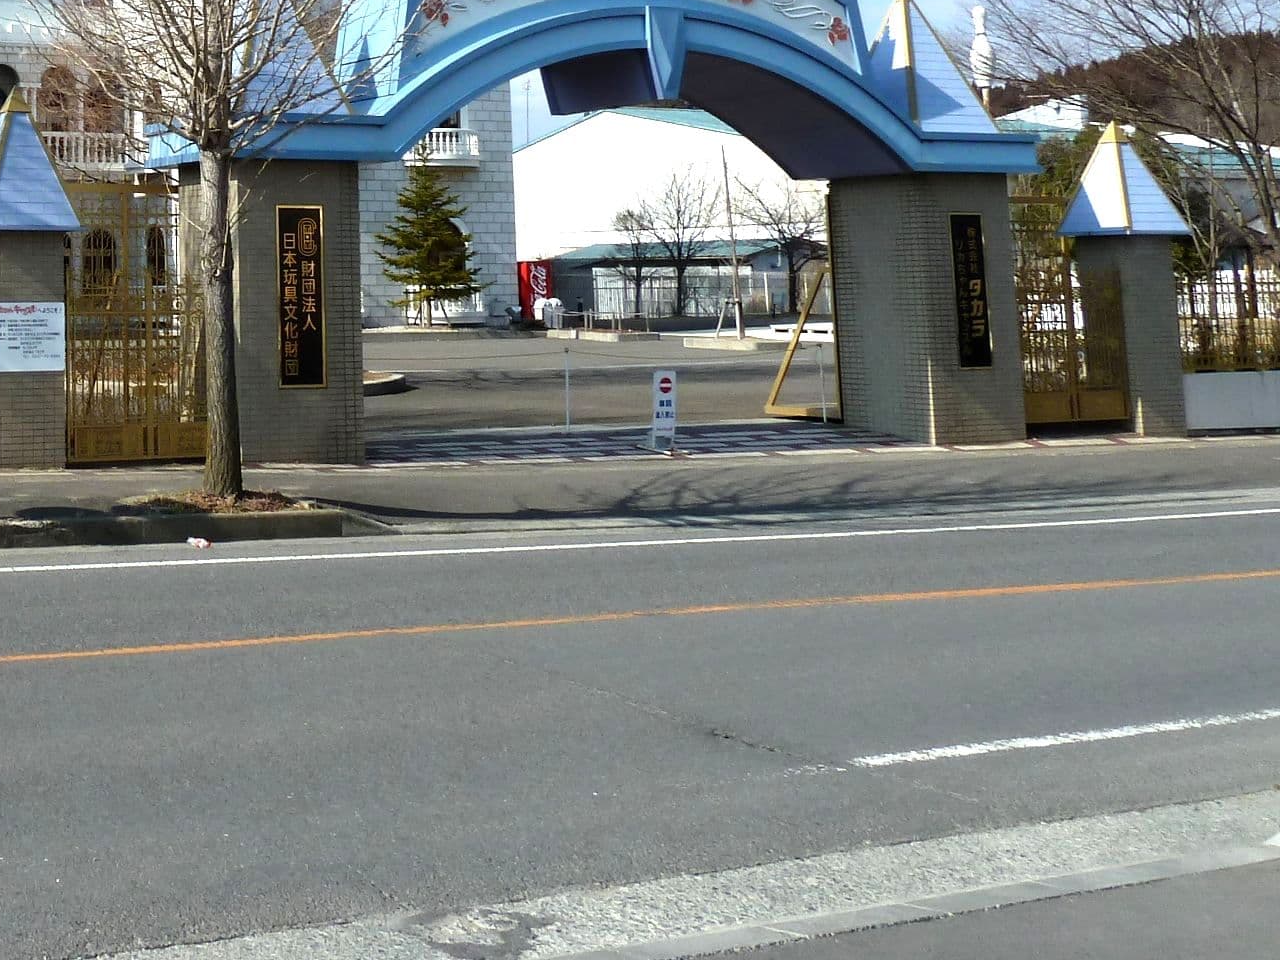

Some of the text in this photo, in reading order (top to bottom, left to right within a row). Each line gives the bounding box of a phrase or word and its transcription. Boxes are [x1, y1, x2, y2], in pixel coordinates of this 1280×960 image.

[282, 232, 299, 376] 日本玩具文化財団
[301, 259, 317, 332] 財団法人
